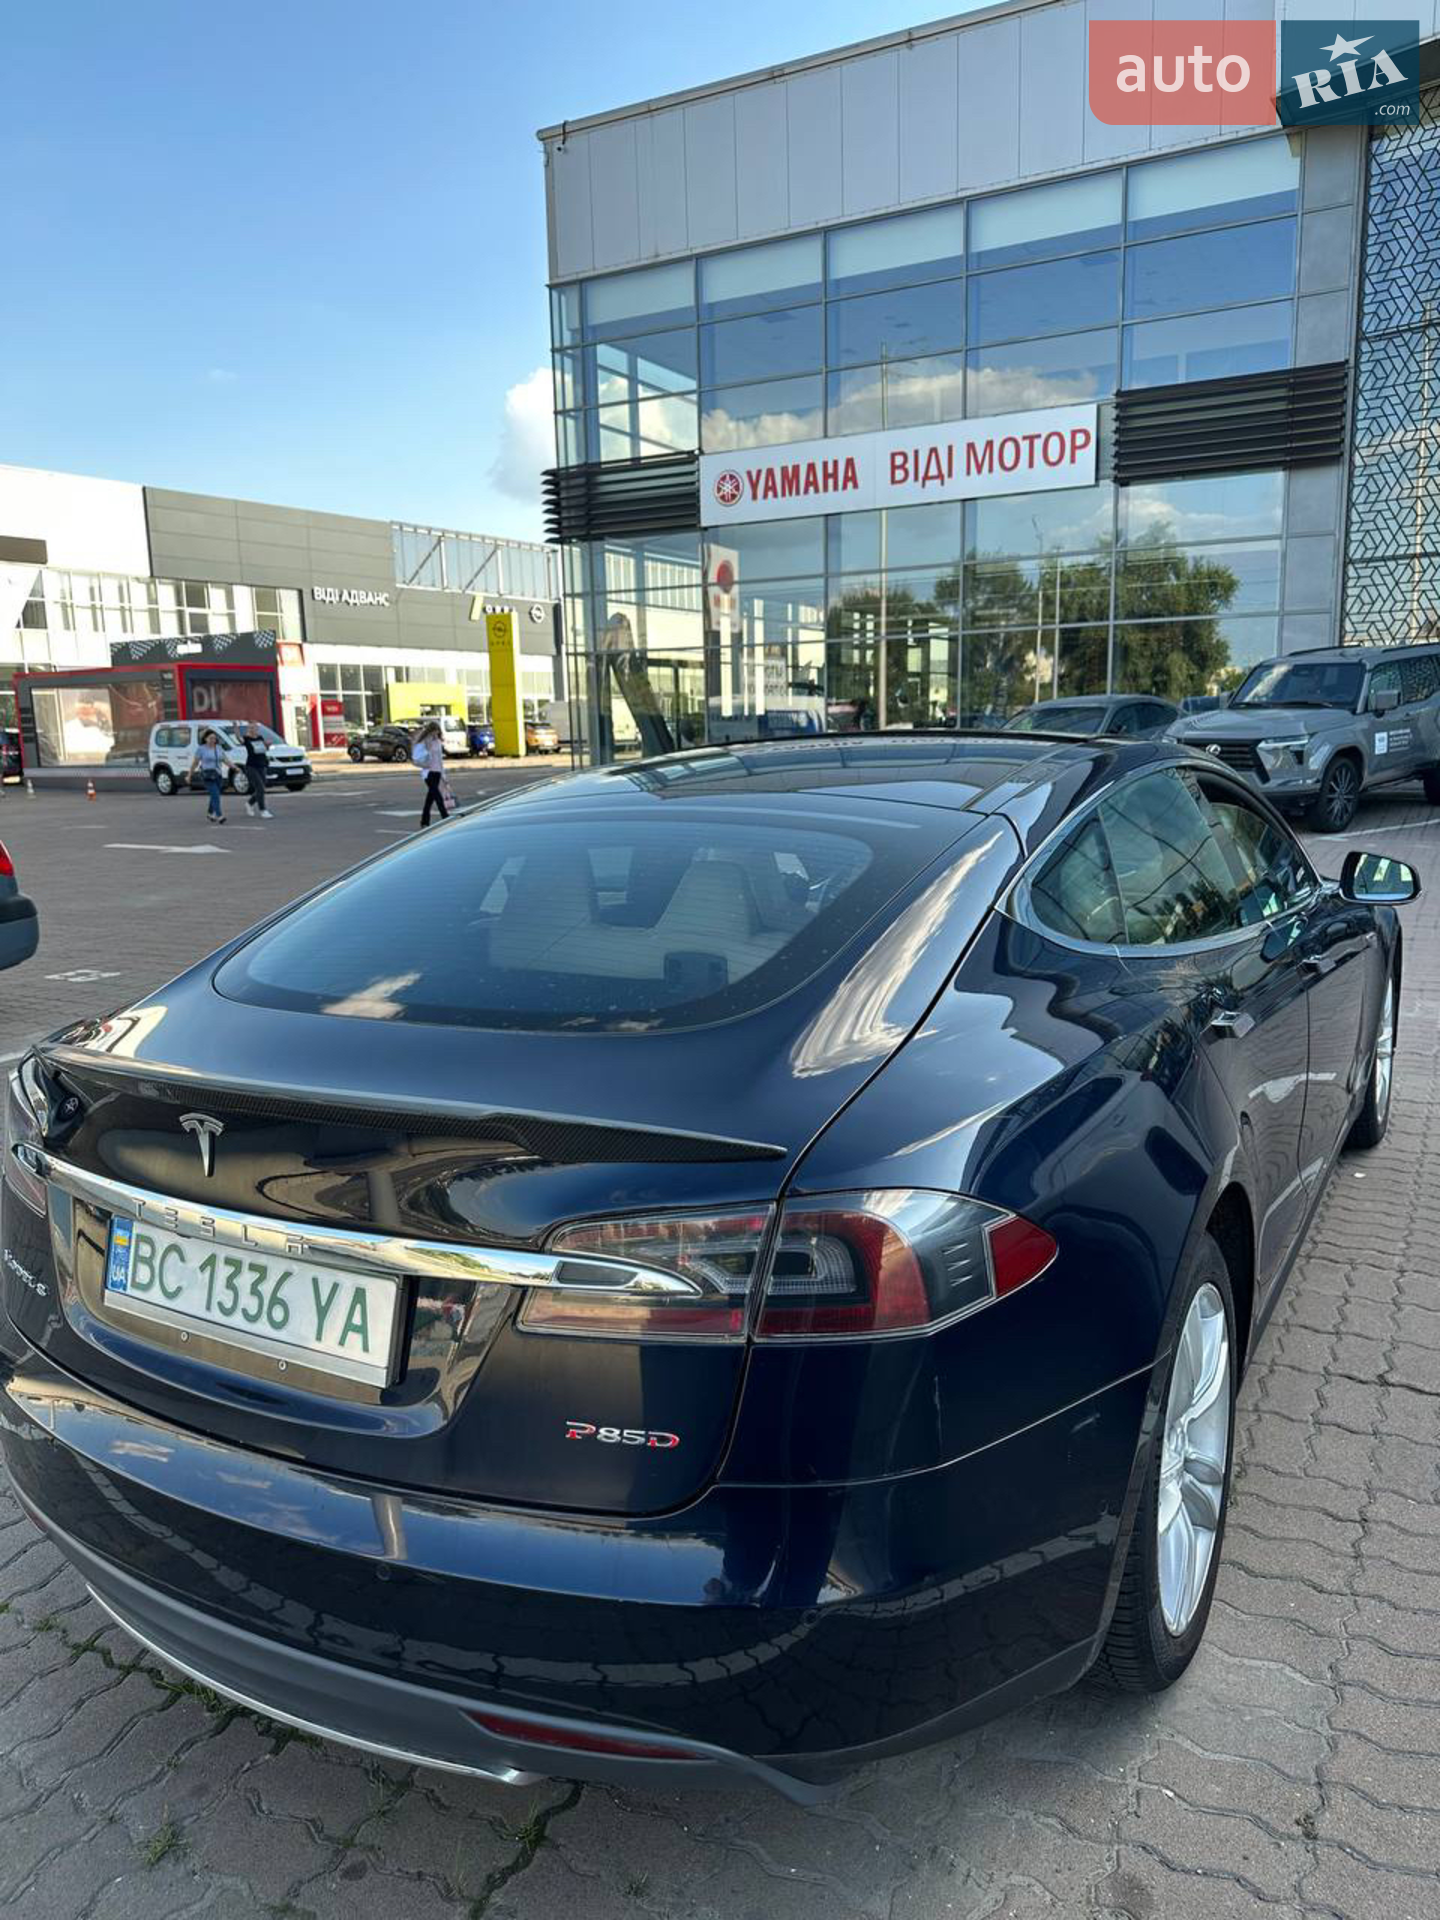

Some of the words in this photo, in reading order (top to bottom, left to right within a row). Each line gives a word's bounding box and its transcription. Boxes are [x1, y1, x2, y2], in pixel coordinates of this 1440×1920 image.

[746, 456, 859, 500] YAMAHA
[890, 444, 954, 488] ВІДІ
[966, 428, 1092, 476] МОТОР
[341, 588, 390, 607] АДВАНС
[132, 1197, 311, 1256] TESLA
[130, 1233, 186, 1301] BC
[199, 1252, 294, 1331] 1336
[311, 1276, 370, 1353] YA
[565, 1421, 680, 1448] P85D
